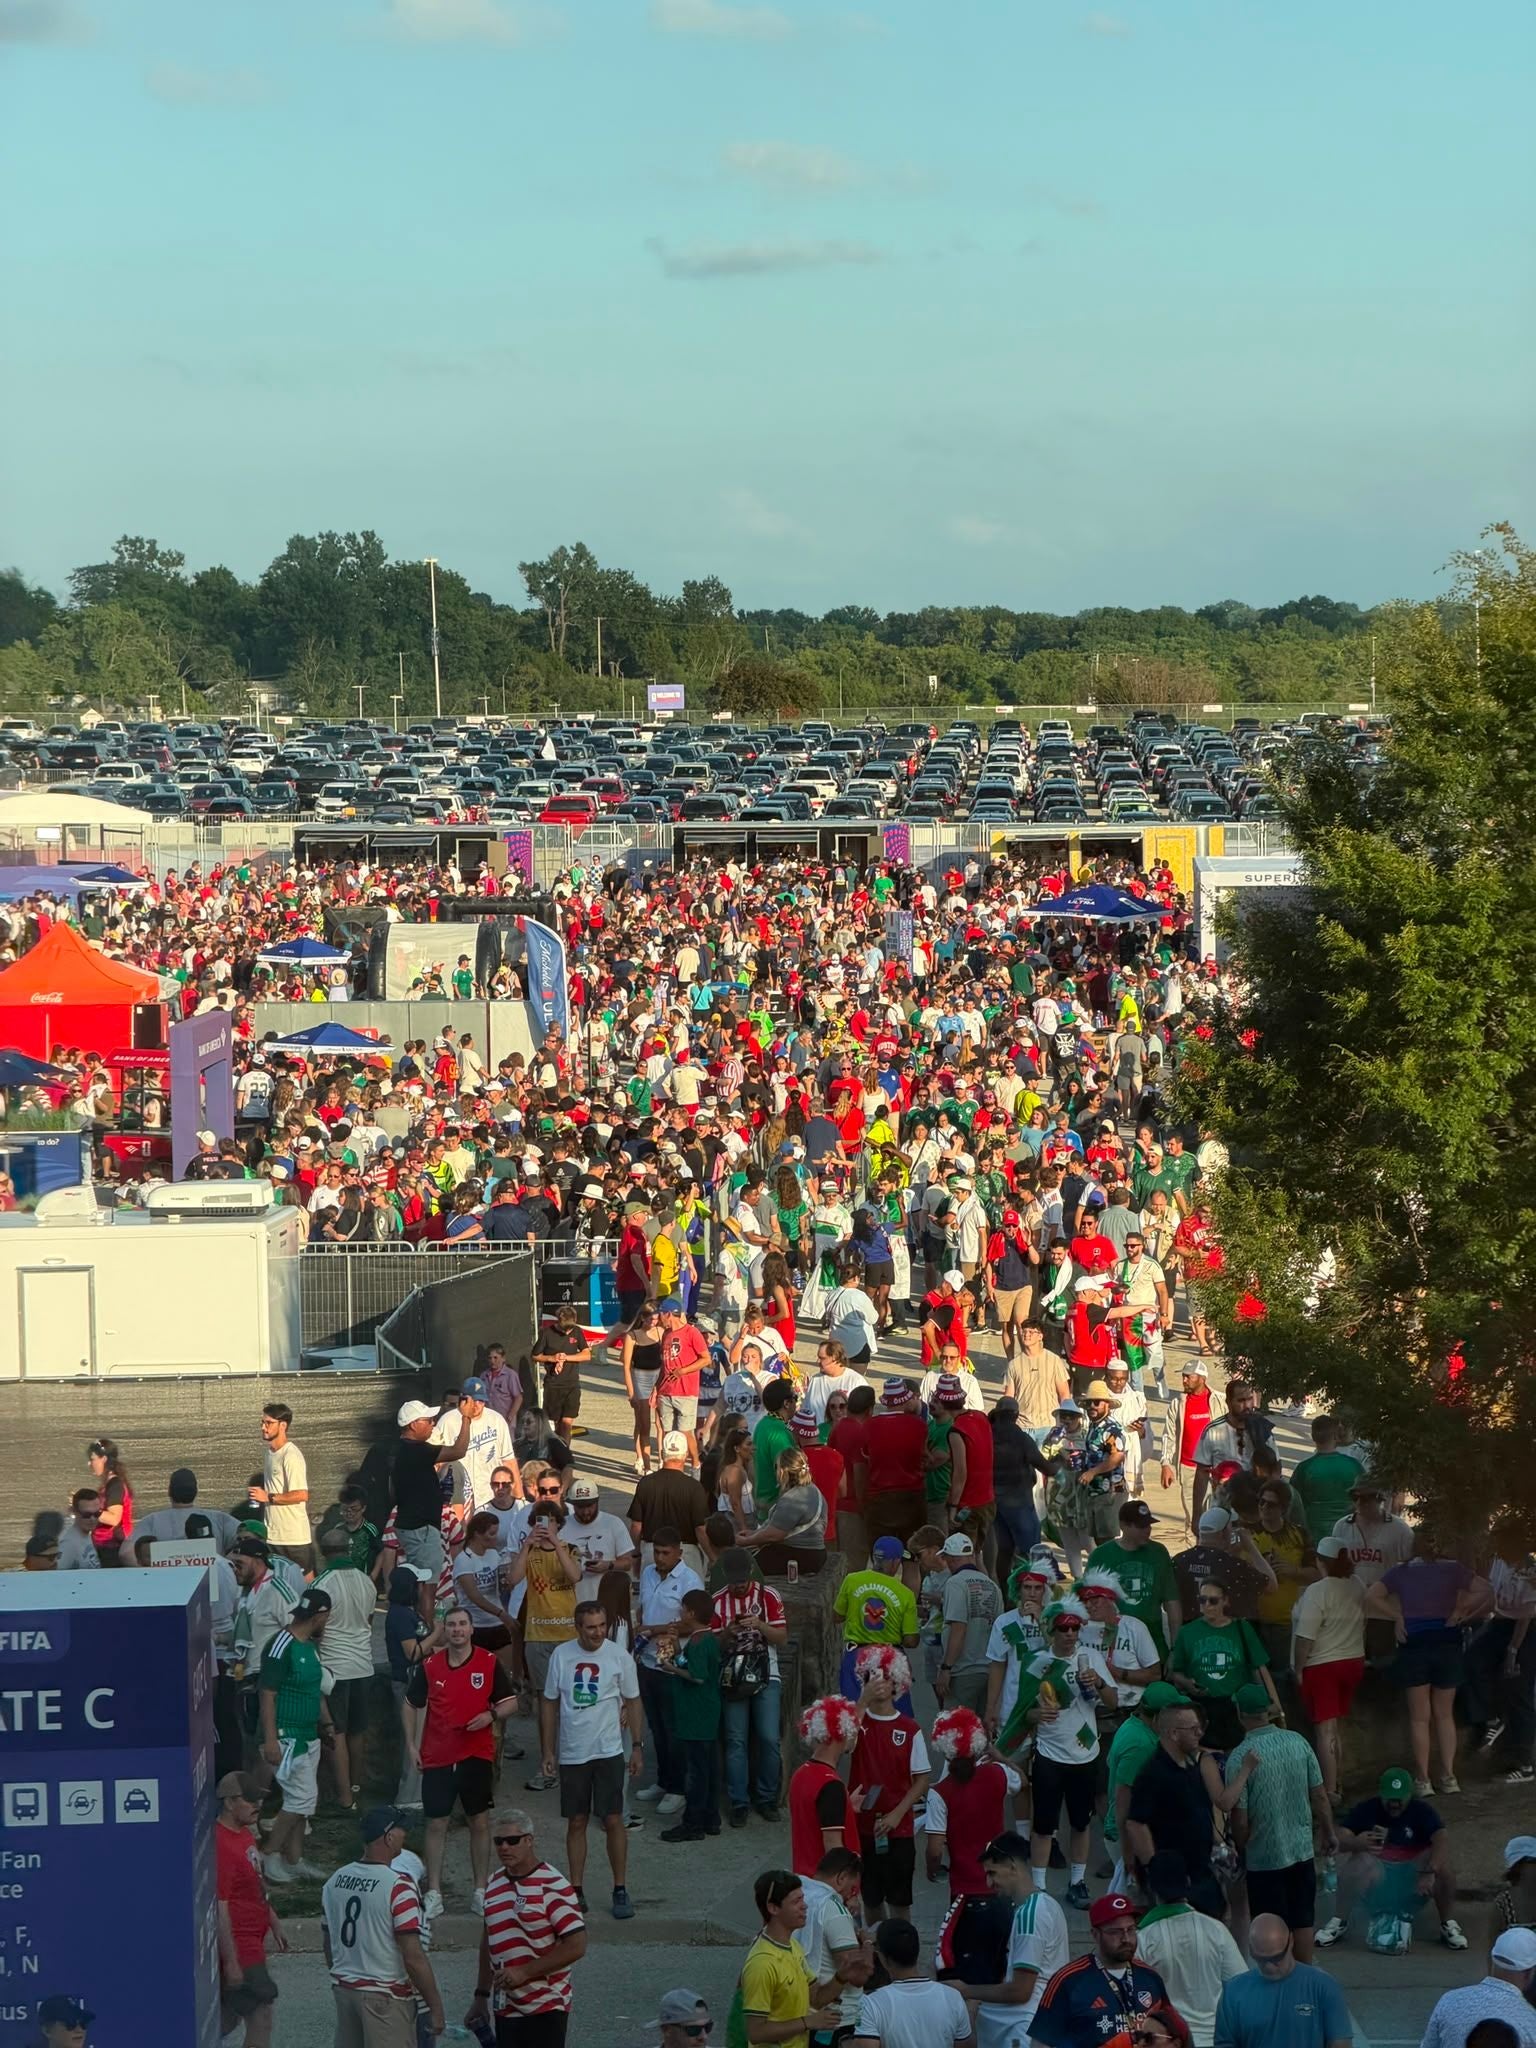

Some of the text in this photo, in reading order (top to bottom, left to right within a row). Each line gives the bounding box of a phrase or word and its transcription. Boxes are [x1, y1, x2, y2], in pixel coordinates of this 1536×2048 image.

[152, 1557, 216, 1567] HELP YOU?
[1350, 1548, 1384, 1563] USA
[853, 1583, 900, 1607] VOLUNTEER
[0, 1631, 52, 1650] FIFA
[84, 1688, 115, 1729] C
[2, 1851, 41, 1869] Fan
[334, 1875, 380, 1893] DEMPSEY
[341, 1896, 361, 1948] 8
